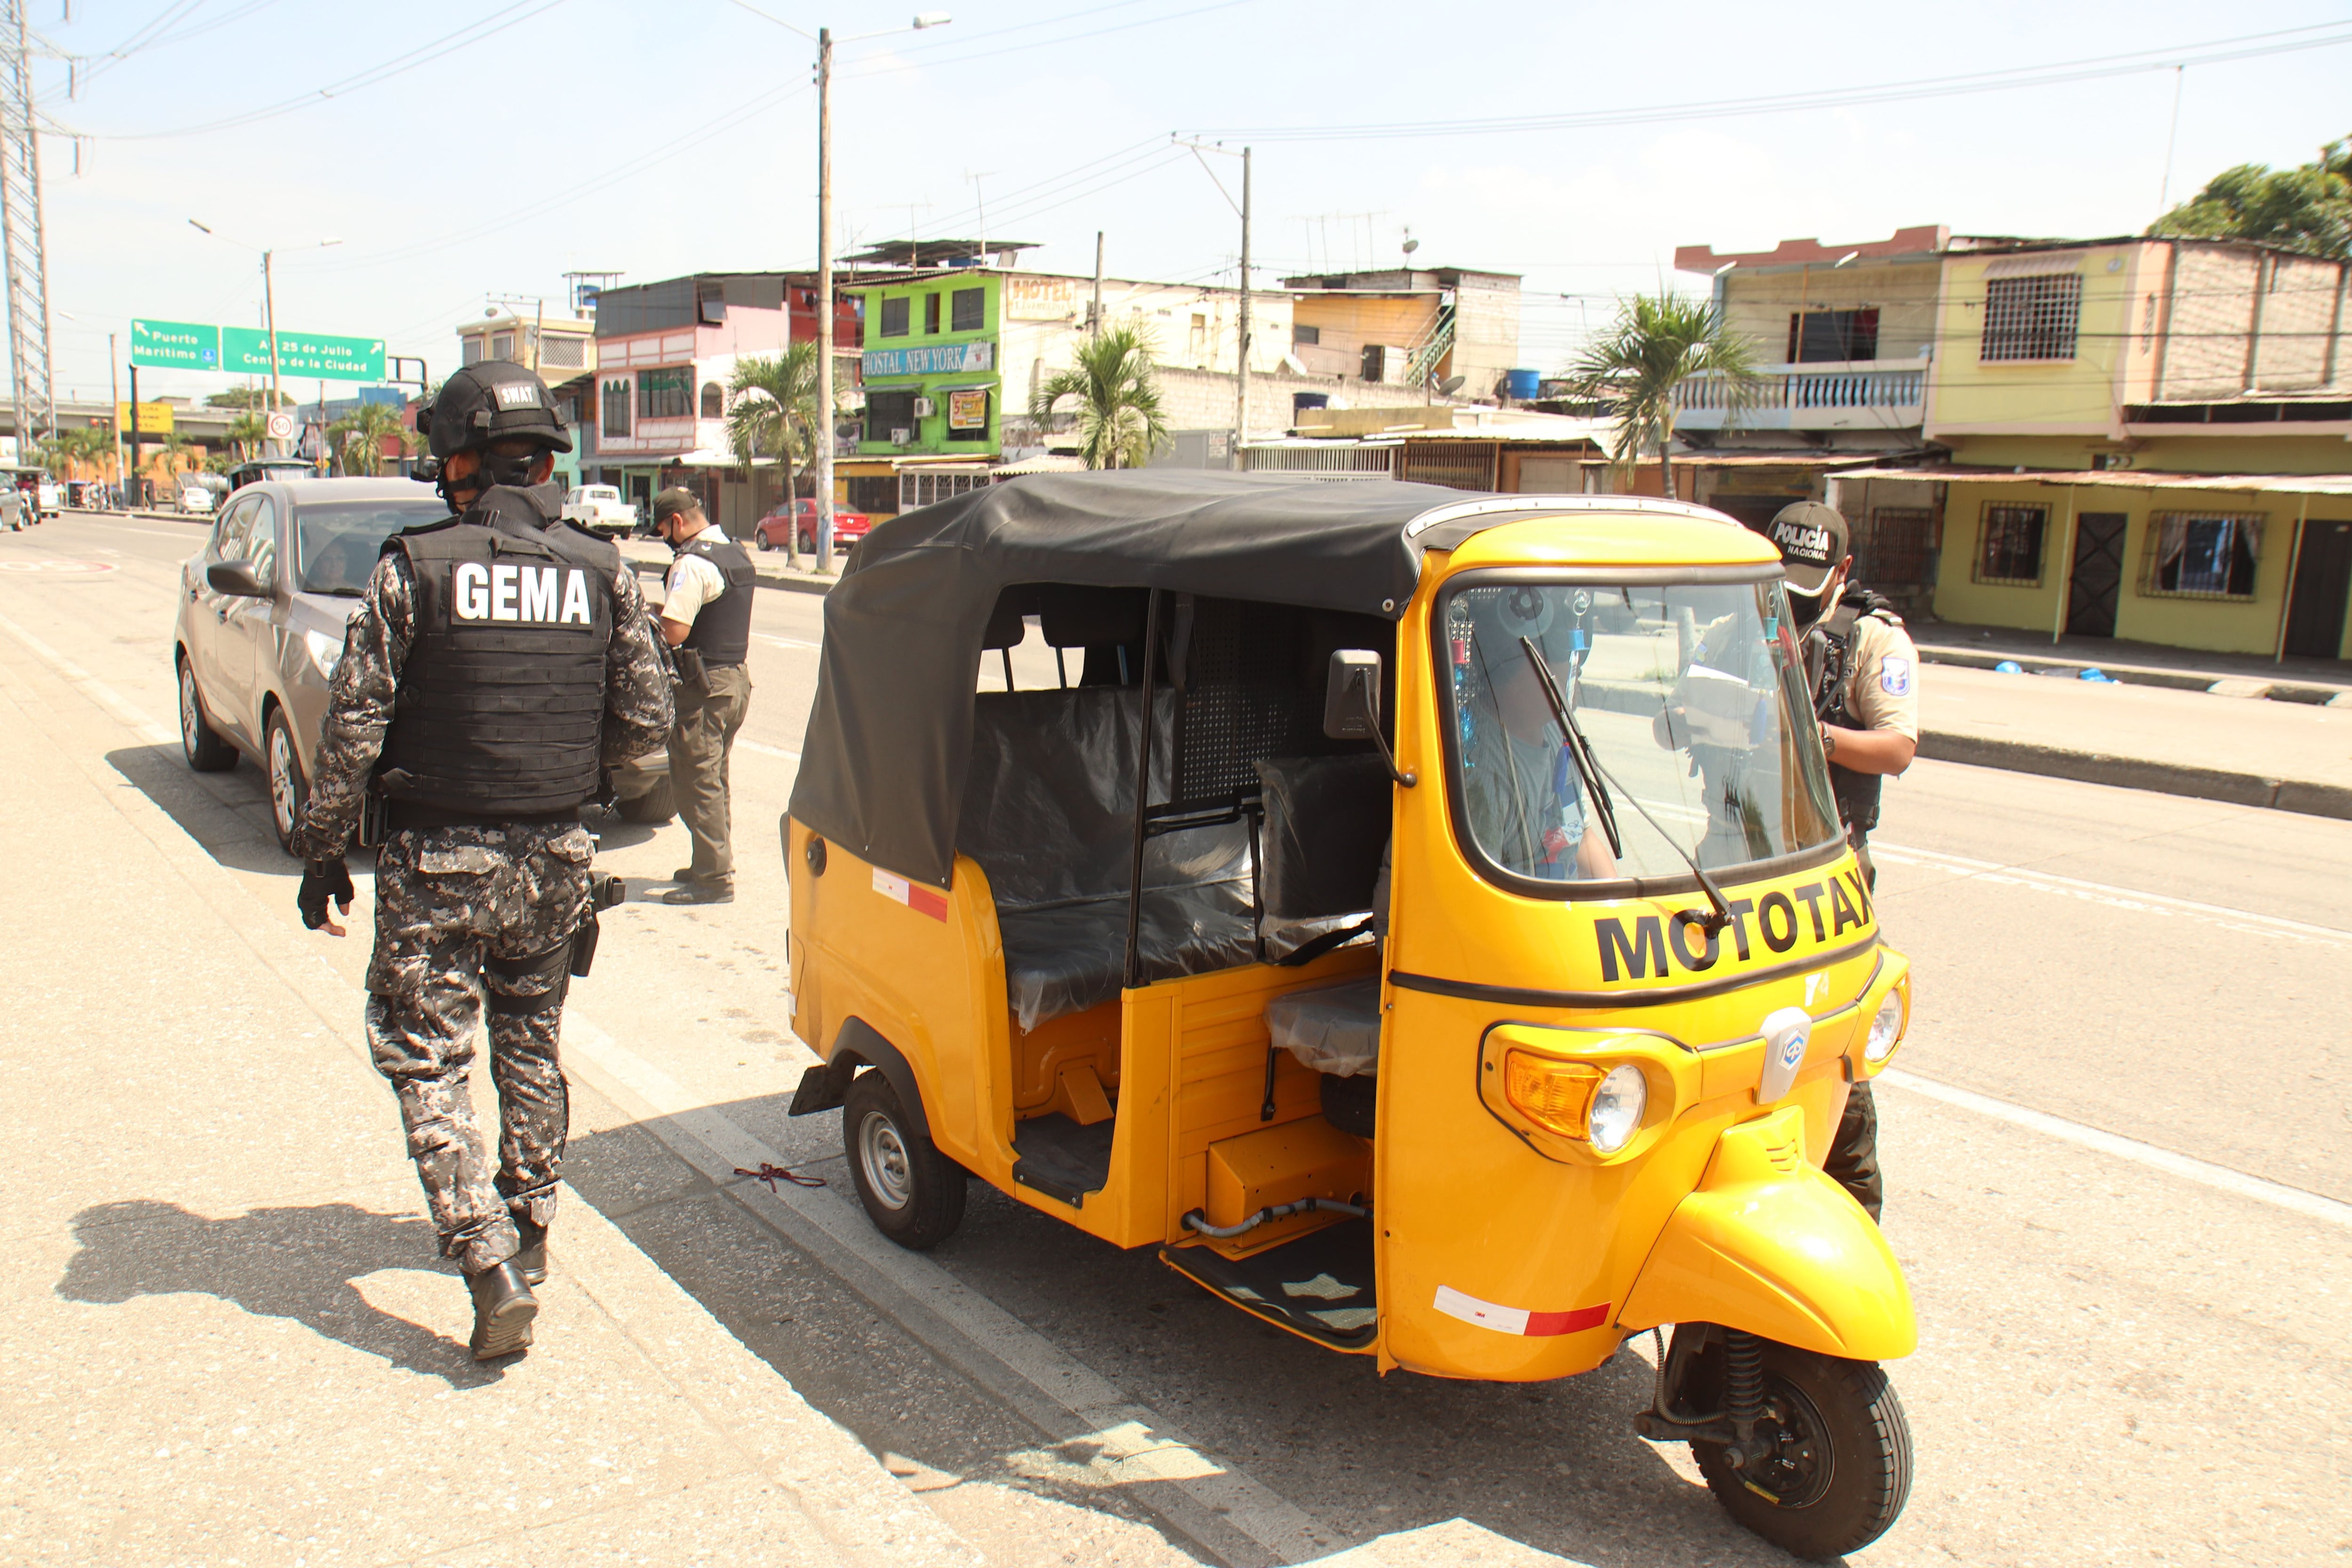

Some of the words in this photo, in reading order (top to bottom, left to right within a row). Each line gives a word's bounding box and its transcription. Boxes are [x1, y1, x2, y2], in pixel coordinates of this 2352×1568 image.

[1014, 280, 1072, 301] HOTEL
[152, 331, 198, 344] Puerto
[282, 341, 298, 352] 25
[302, 344, 317, 353] de
[320, 344, 352, 356] Julio
[243, 353, 286, 366] Cento
[290, 358, 304, 367] de
[309, 358, 321, 368] la
[325, 360, 367, 372] Ciudad
[863, 351, 901, 375] HOSTAL
[906, 349, 930, 372] NEW
[931, 347, 963, 371] YORK
[501, 386, 533, 404] SWAT
[275, 421, 288, 430] 50
[1774, 522, 1829, 551] POLICÍA
[1788, 545, 1827, 561] NACIONAL
[456, 563, 592, 625] GEMA
